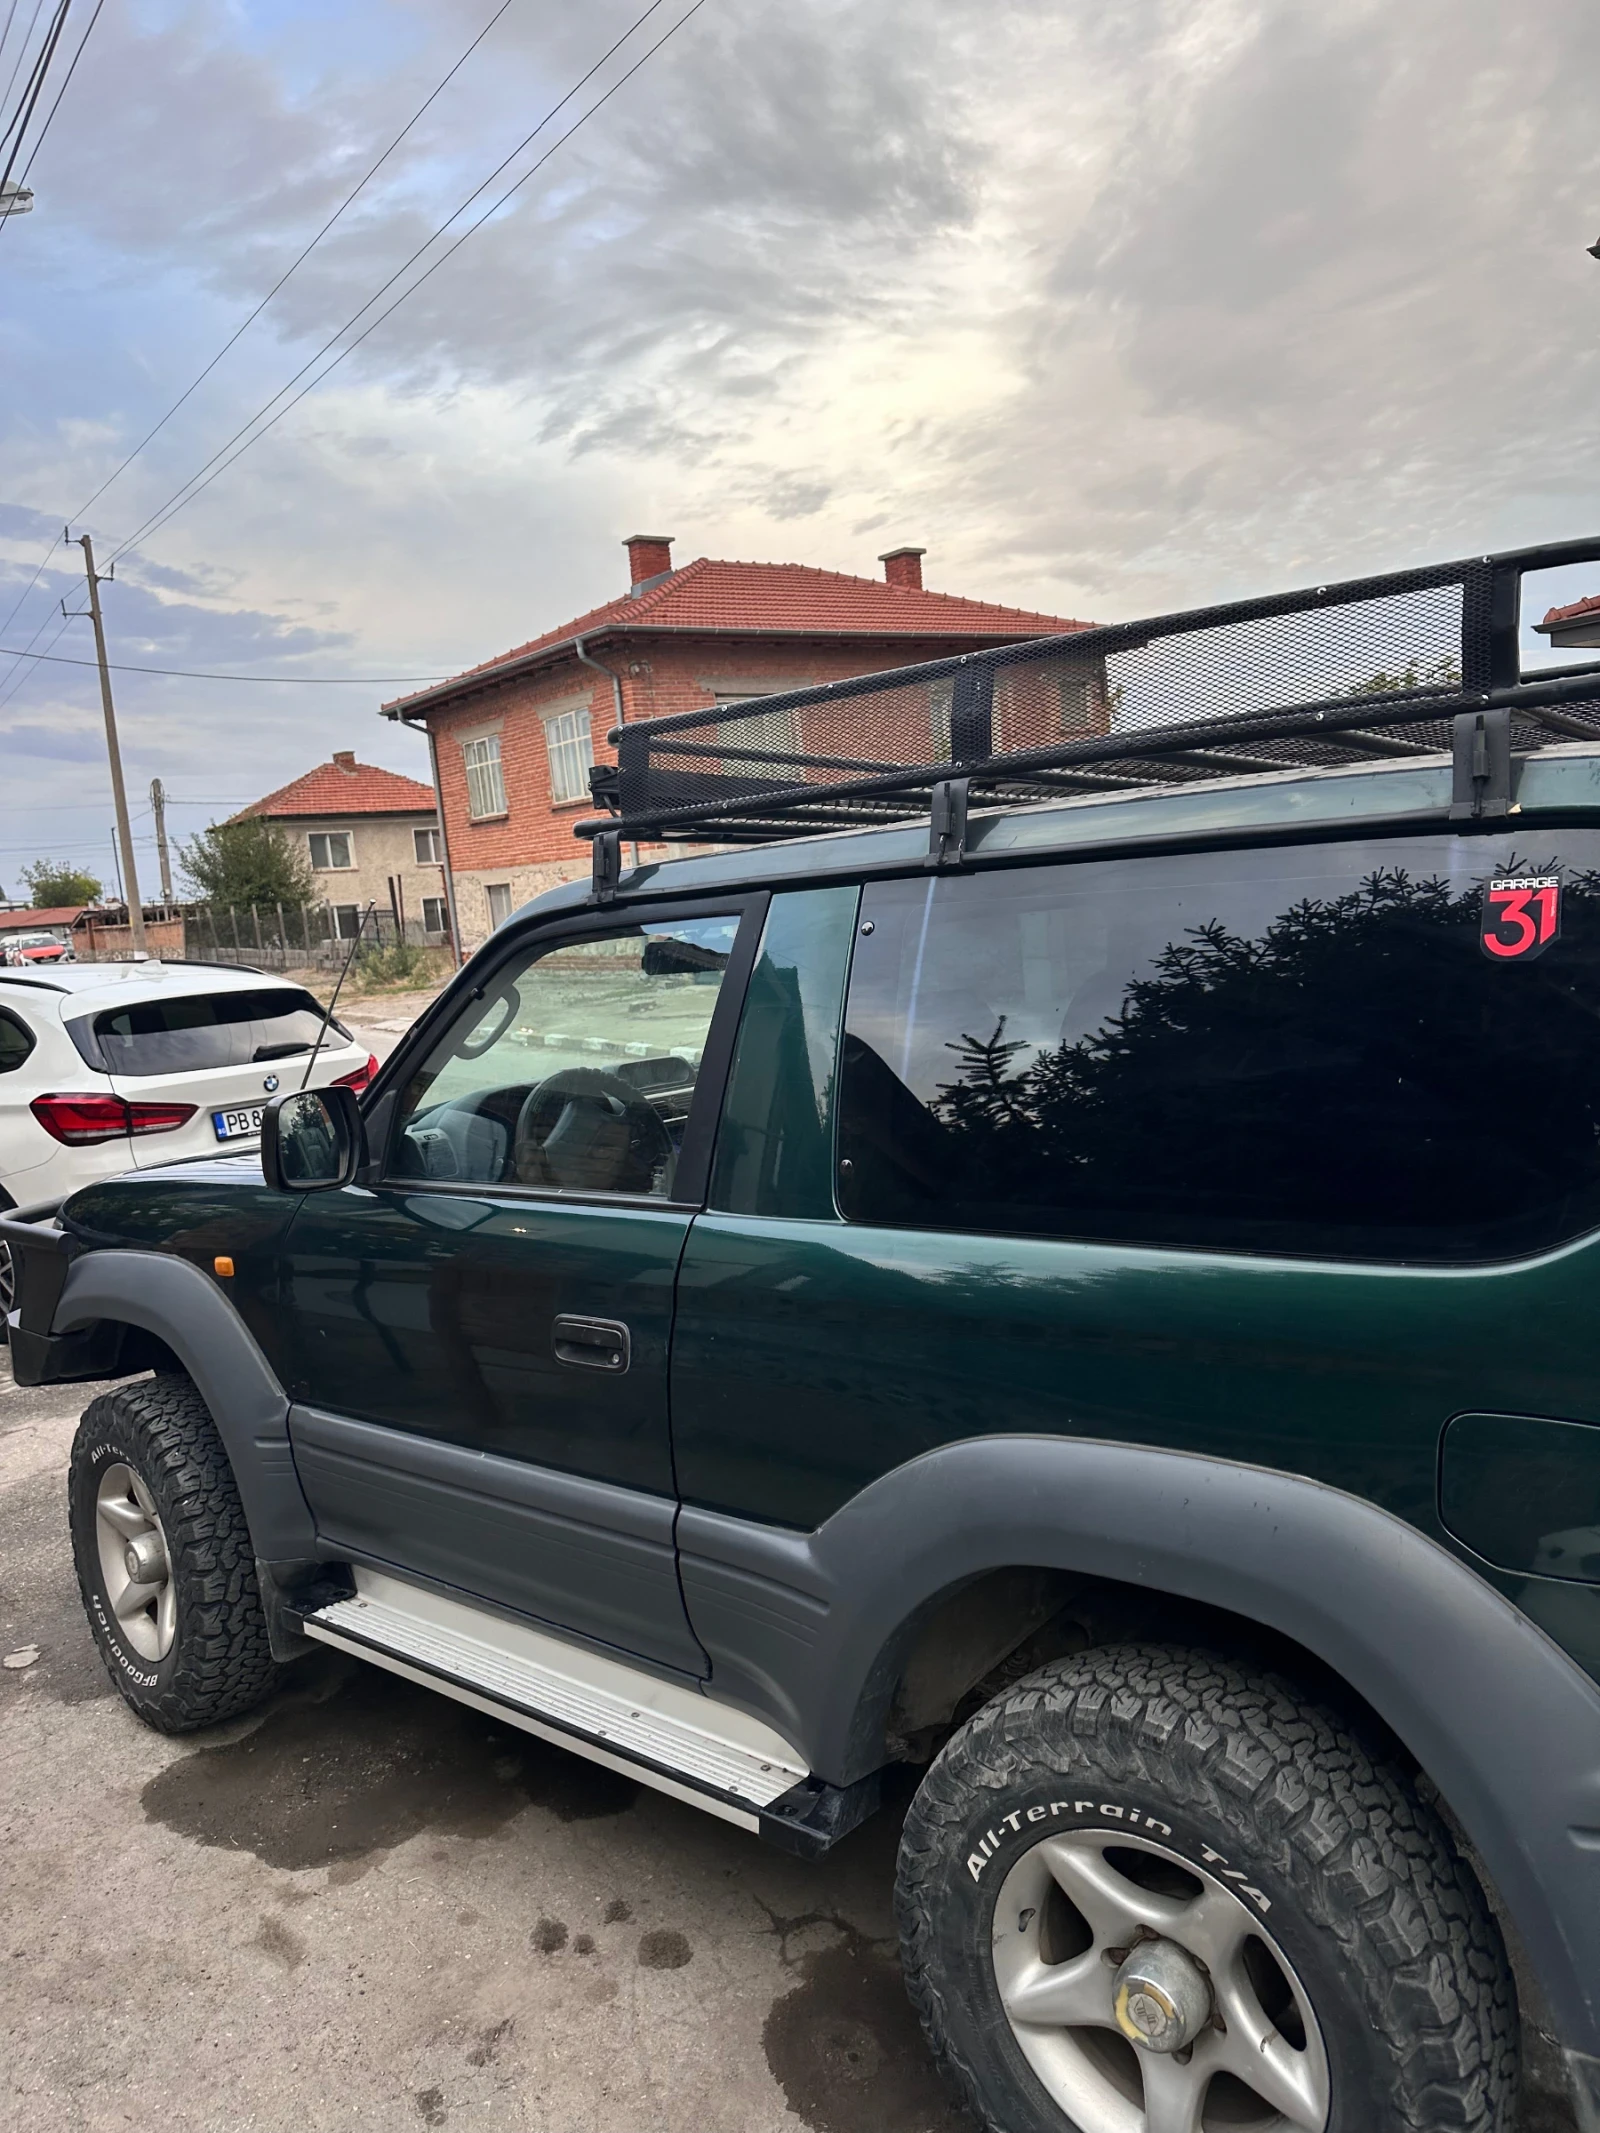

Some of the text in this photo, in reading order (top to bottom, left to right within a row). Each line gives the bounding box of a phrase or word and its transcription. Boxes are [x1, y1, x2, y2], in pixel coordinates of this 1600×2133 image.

[1490, 876, 1559, 891] GARAGE
[1484, 888, 1558, 957] 31
[226, 1112, 250, 1133] PB
[93, 1595, 159, 1687] BFGoodrich
[966, 1800, 1272, 1913] All-Terrain T/A
